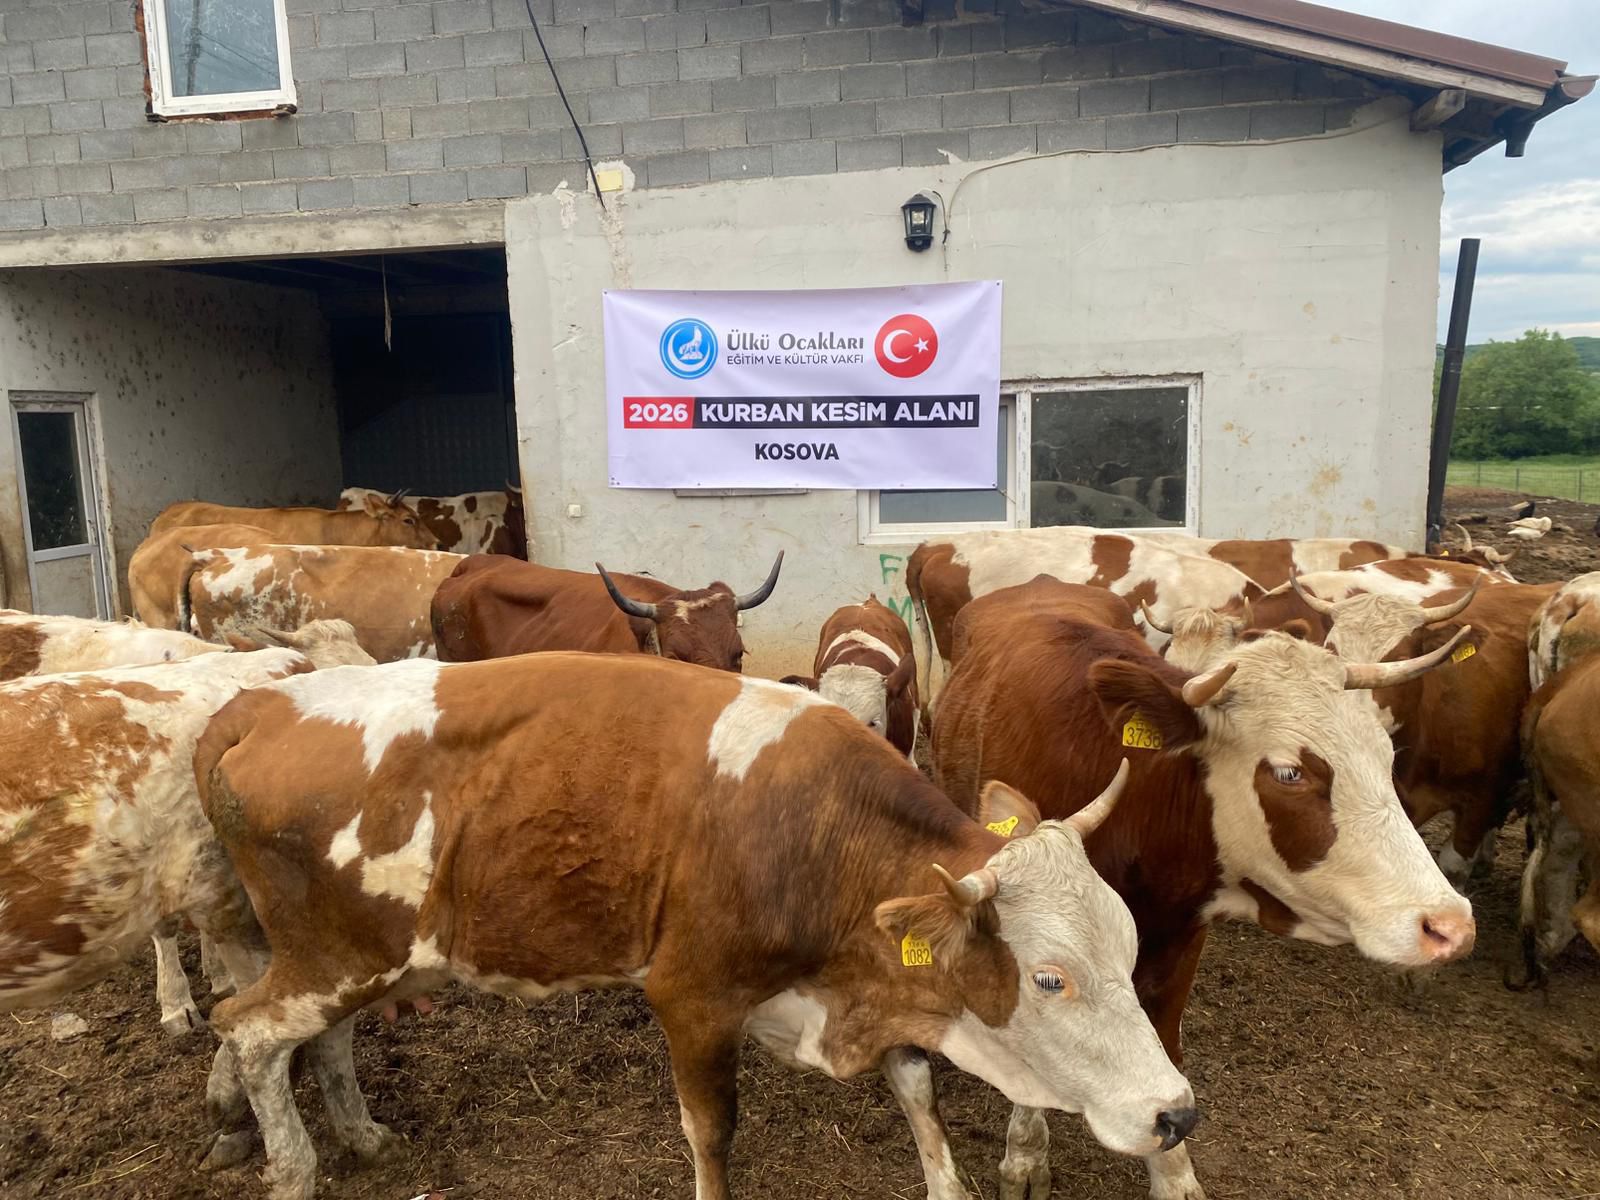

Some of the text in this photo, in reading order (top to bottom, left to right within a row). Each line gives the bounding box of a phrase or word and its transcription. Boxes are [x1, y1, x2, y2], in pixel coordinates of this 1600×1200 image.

[727, 329, 770, 351] Ülkü
[727, 352, 864, 365] EĞİTİM VE KÜLTÜR VAKFI
[628, 403, 689, 422] 2026
[701, 403, 804, 422] KURBAN
[893, 401, 975, 422] ALANI
[754, 443, 840, 461] KOSOVA
[904, 948, 930, 965] 1082
